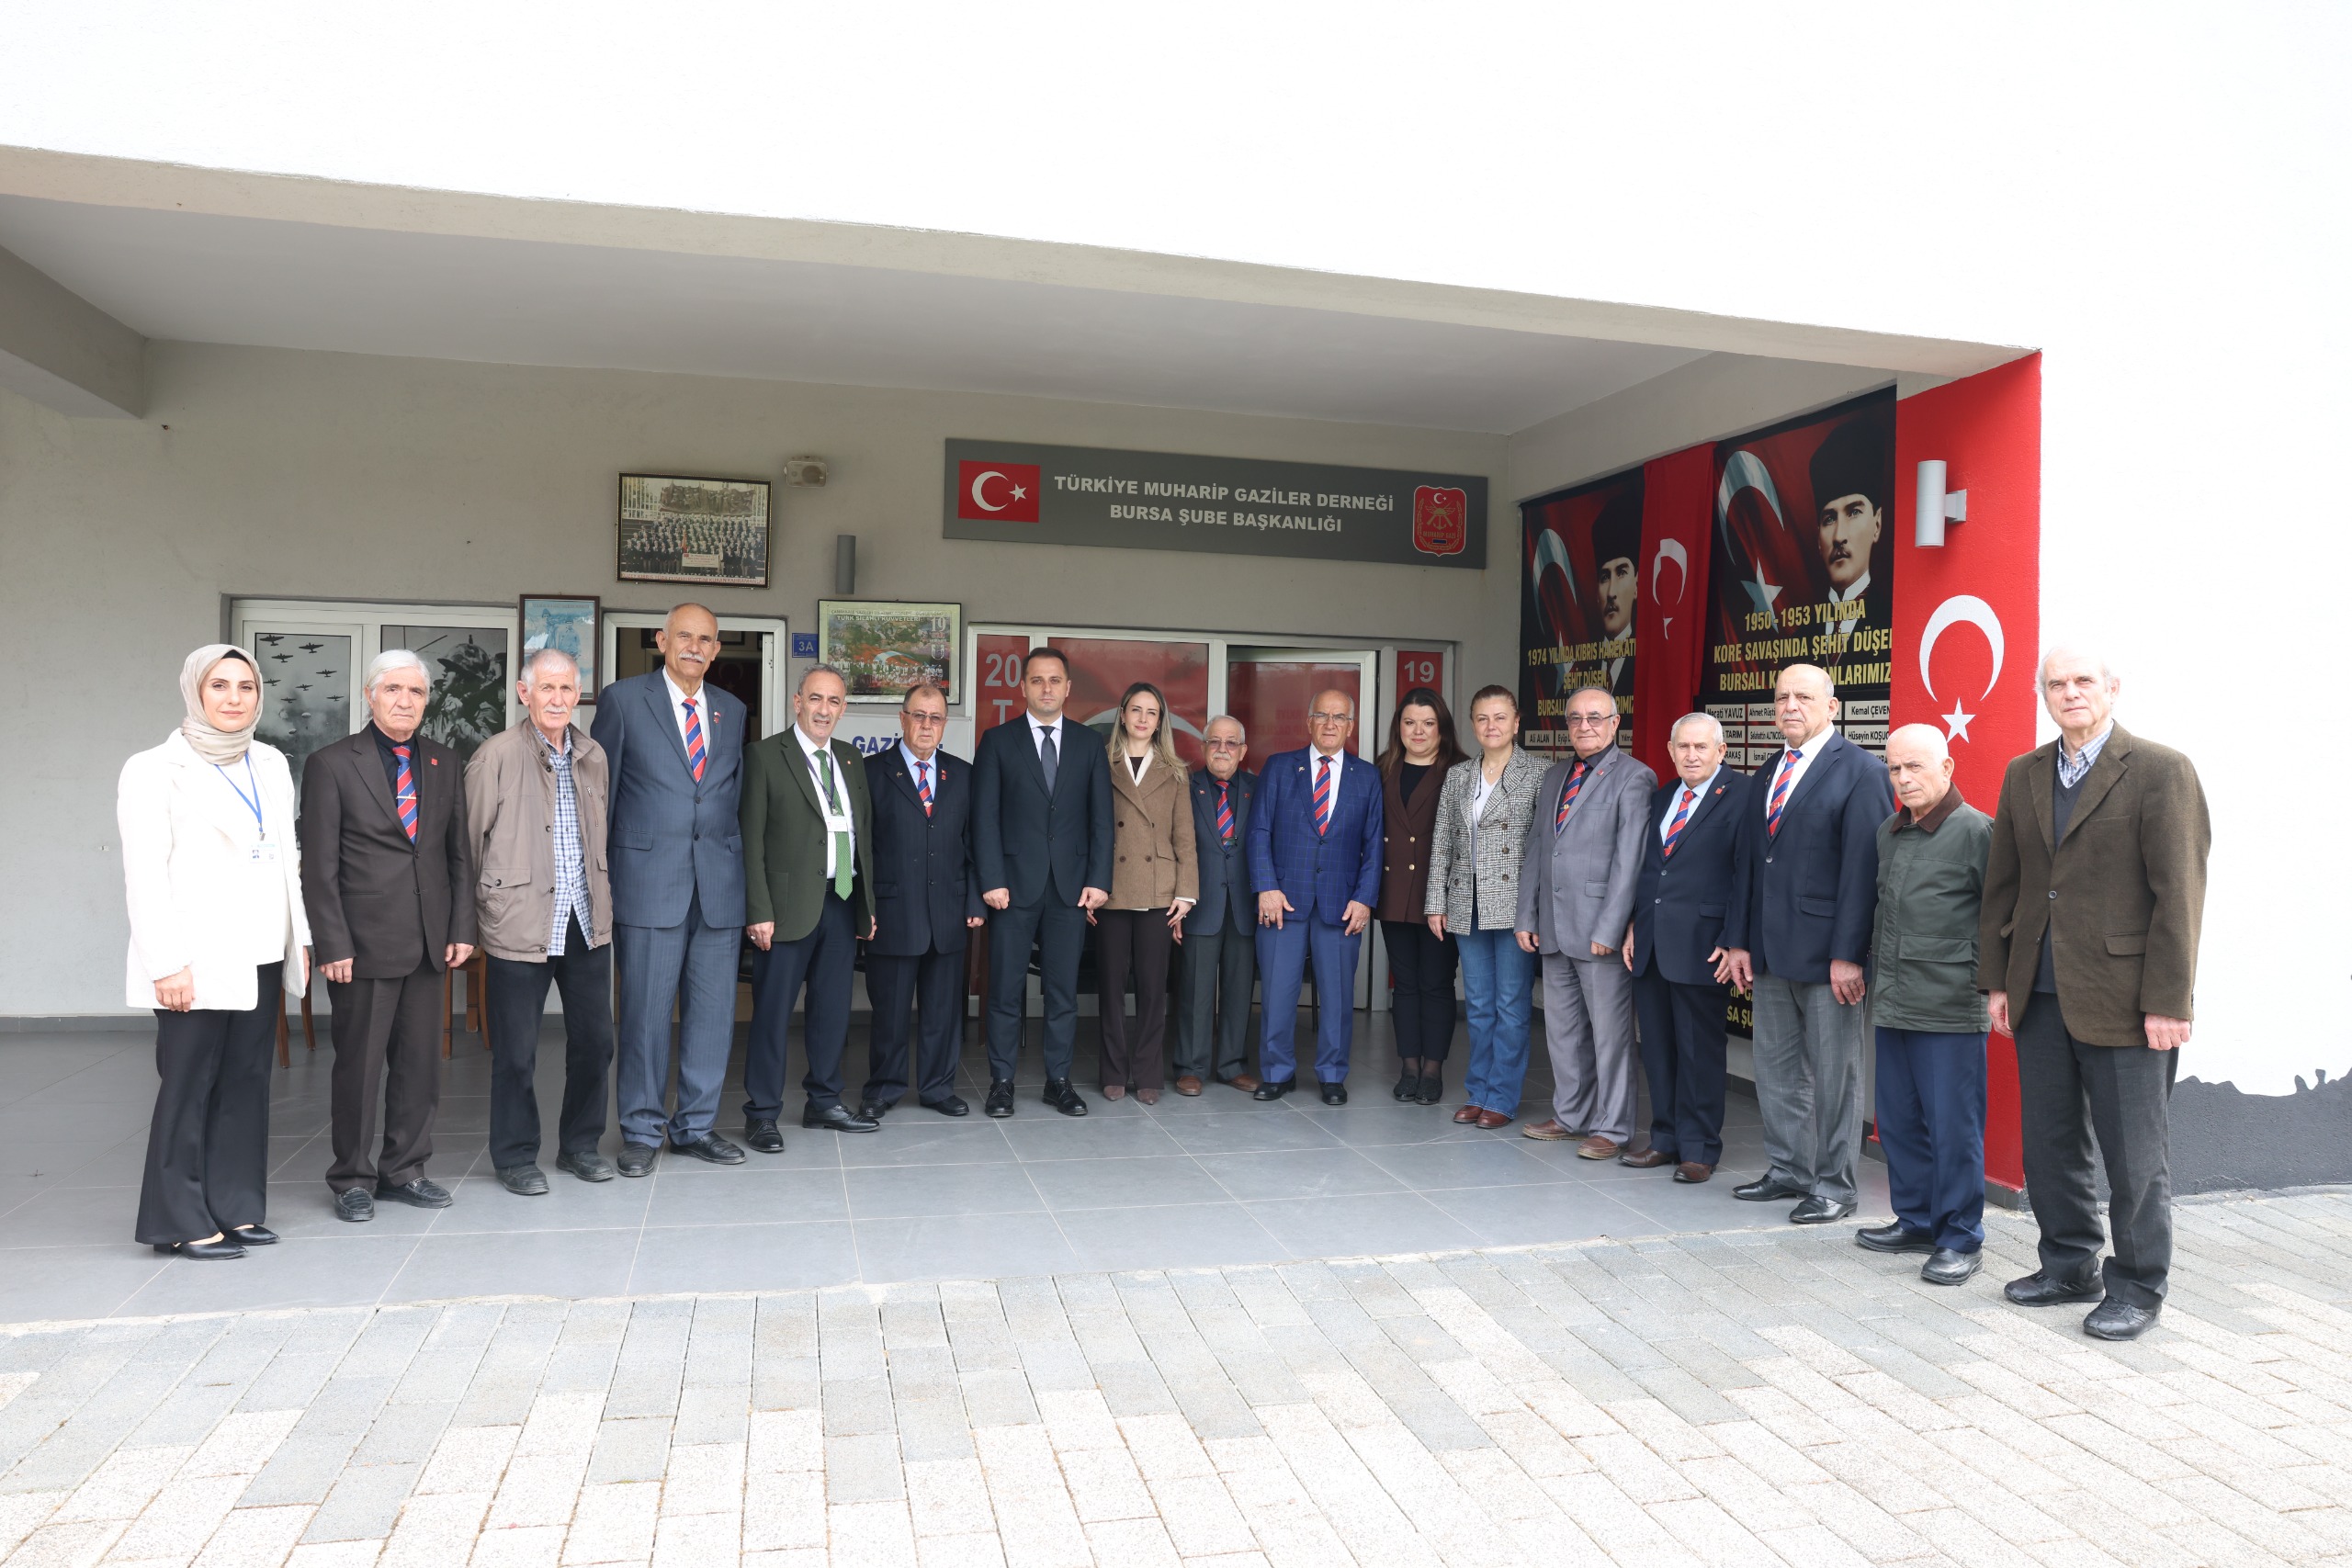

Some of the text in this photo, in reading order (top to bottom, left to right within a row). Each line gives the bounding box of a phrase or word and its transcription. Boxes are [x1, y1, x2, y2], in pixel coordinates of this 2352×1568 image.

[1055, 473, 1394, 512] TÜRKİYE MUHARİP GAZİLER DERNEĞİ
[1110, 504, 1341, 532] BURSA ŞUBE BAŞKANLIĞI
[931, 616, 946, 632] 19
[1745, 610, 1772, 632] 1950
[1781, 608, 1811, 627] 1953
[1815, 598, 1866, 624] YILINDA
[798, 641, 814, 652] 3A
[1527, 647, 1547, 667] 1974
[1549, 645, 1575, 664] YILINDA
[1575, 642, 1598, 662] KIBRIS
[1713, 643, 1742, 664] KORE
[1745, 637, 1809, 664] SAVAŞINDA
[1812, 628, 1850, 660] ŞEHİT
[984, 653, 1022, 688] 20
[1404, 660, 1435, 683] 19
[1563, 667, 1582, 694] ŞEHİT
[1719, 671, 1766, 691] BURSALI
[1537, 699, 1565, 716] BURSALI
[1724, 707, 1744, 719] YAVUZ
[1748, 707, 1763, 716] Ahmet
[1851, 705, 1870, 716] Kemal
[1537, 734, 1550, 743] ALAN
[1724, 729, 1743, 739] TARIM
[1848, 730, 1870, 743] Hüseyin
